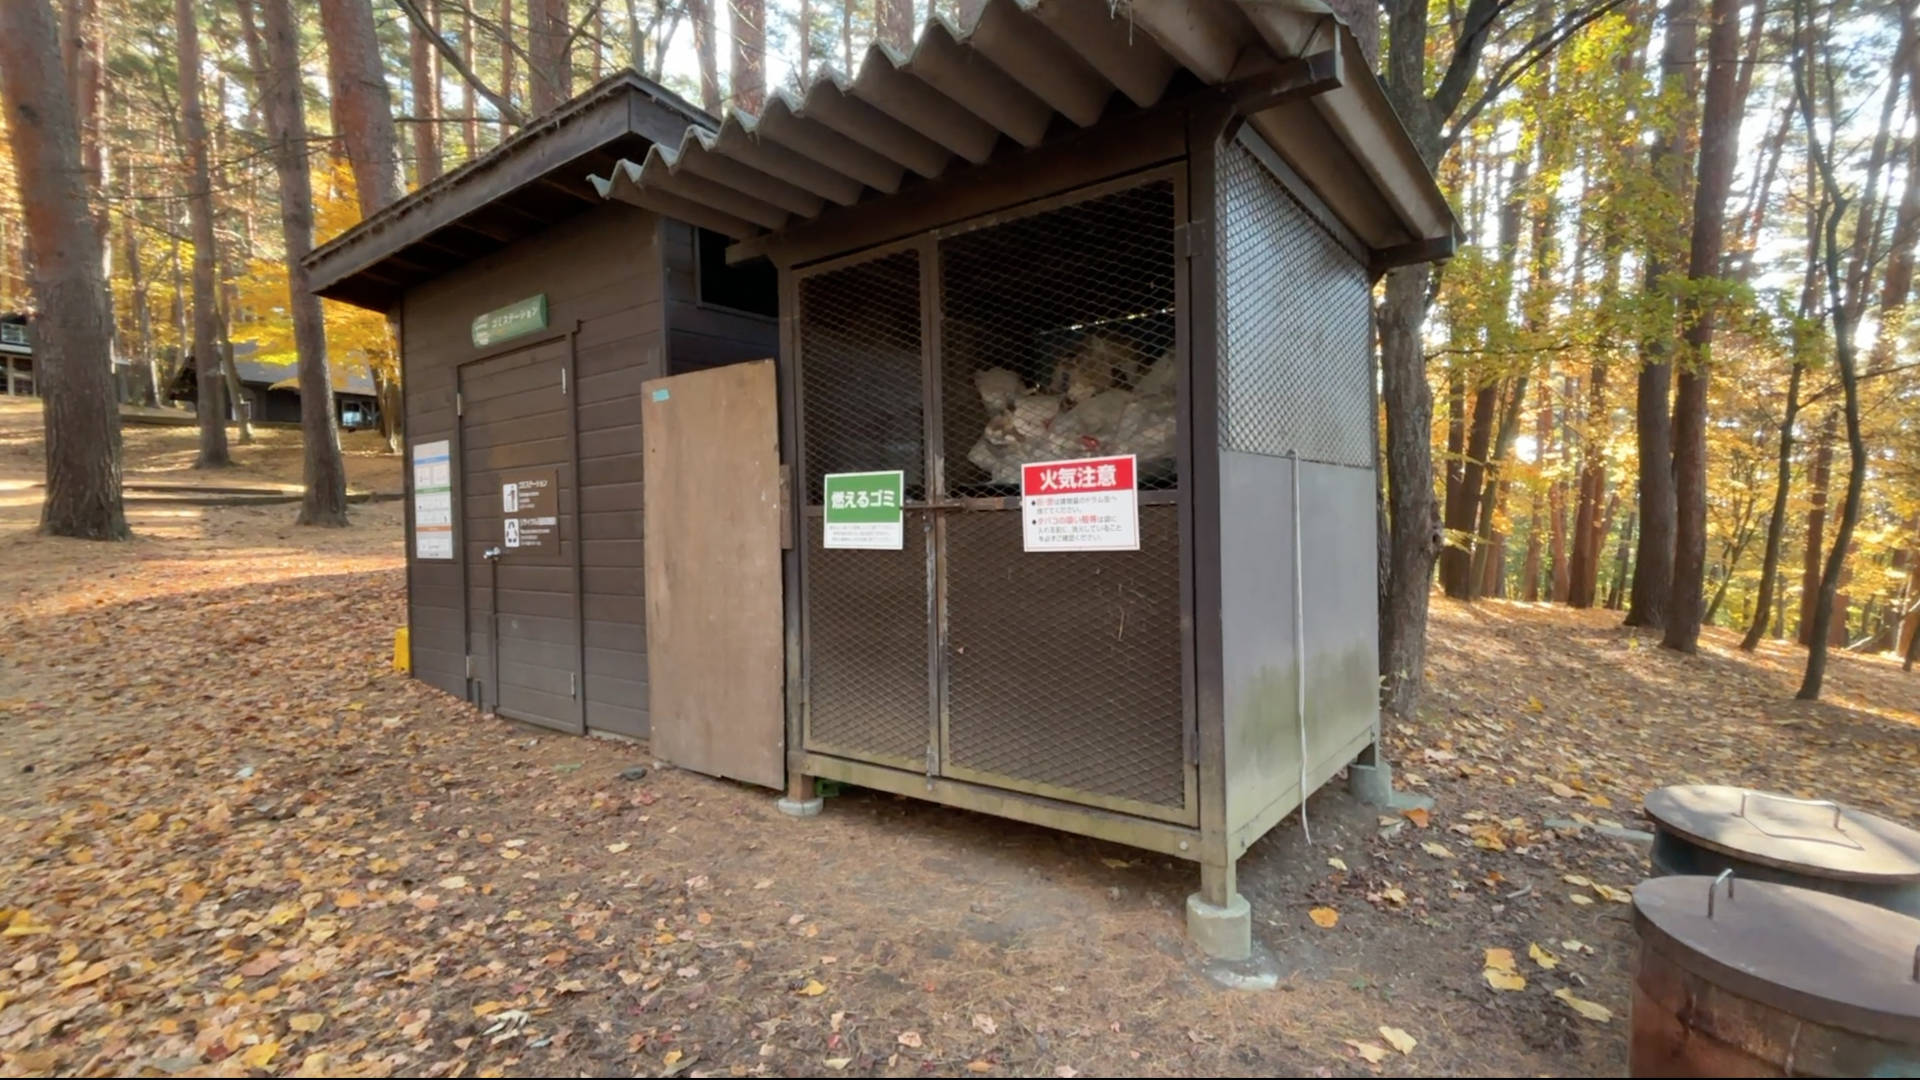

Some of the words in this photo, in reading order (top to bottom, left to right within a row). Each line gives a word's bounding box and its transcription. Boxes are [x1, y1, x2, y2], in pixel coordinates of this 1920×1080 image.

[1040, 464, 1117, 490] 火気注意
[831, 490, 895, 509] 燃えるゴミ
